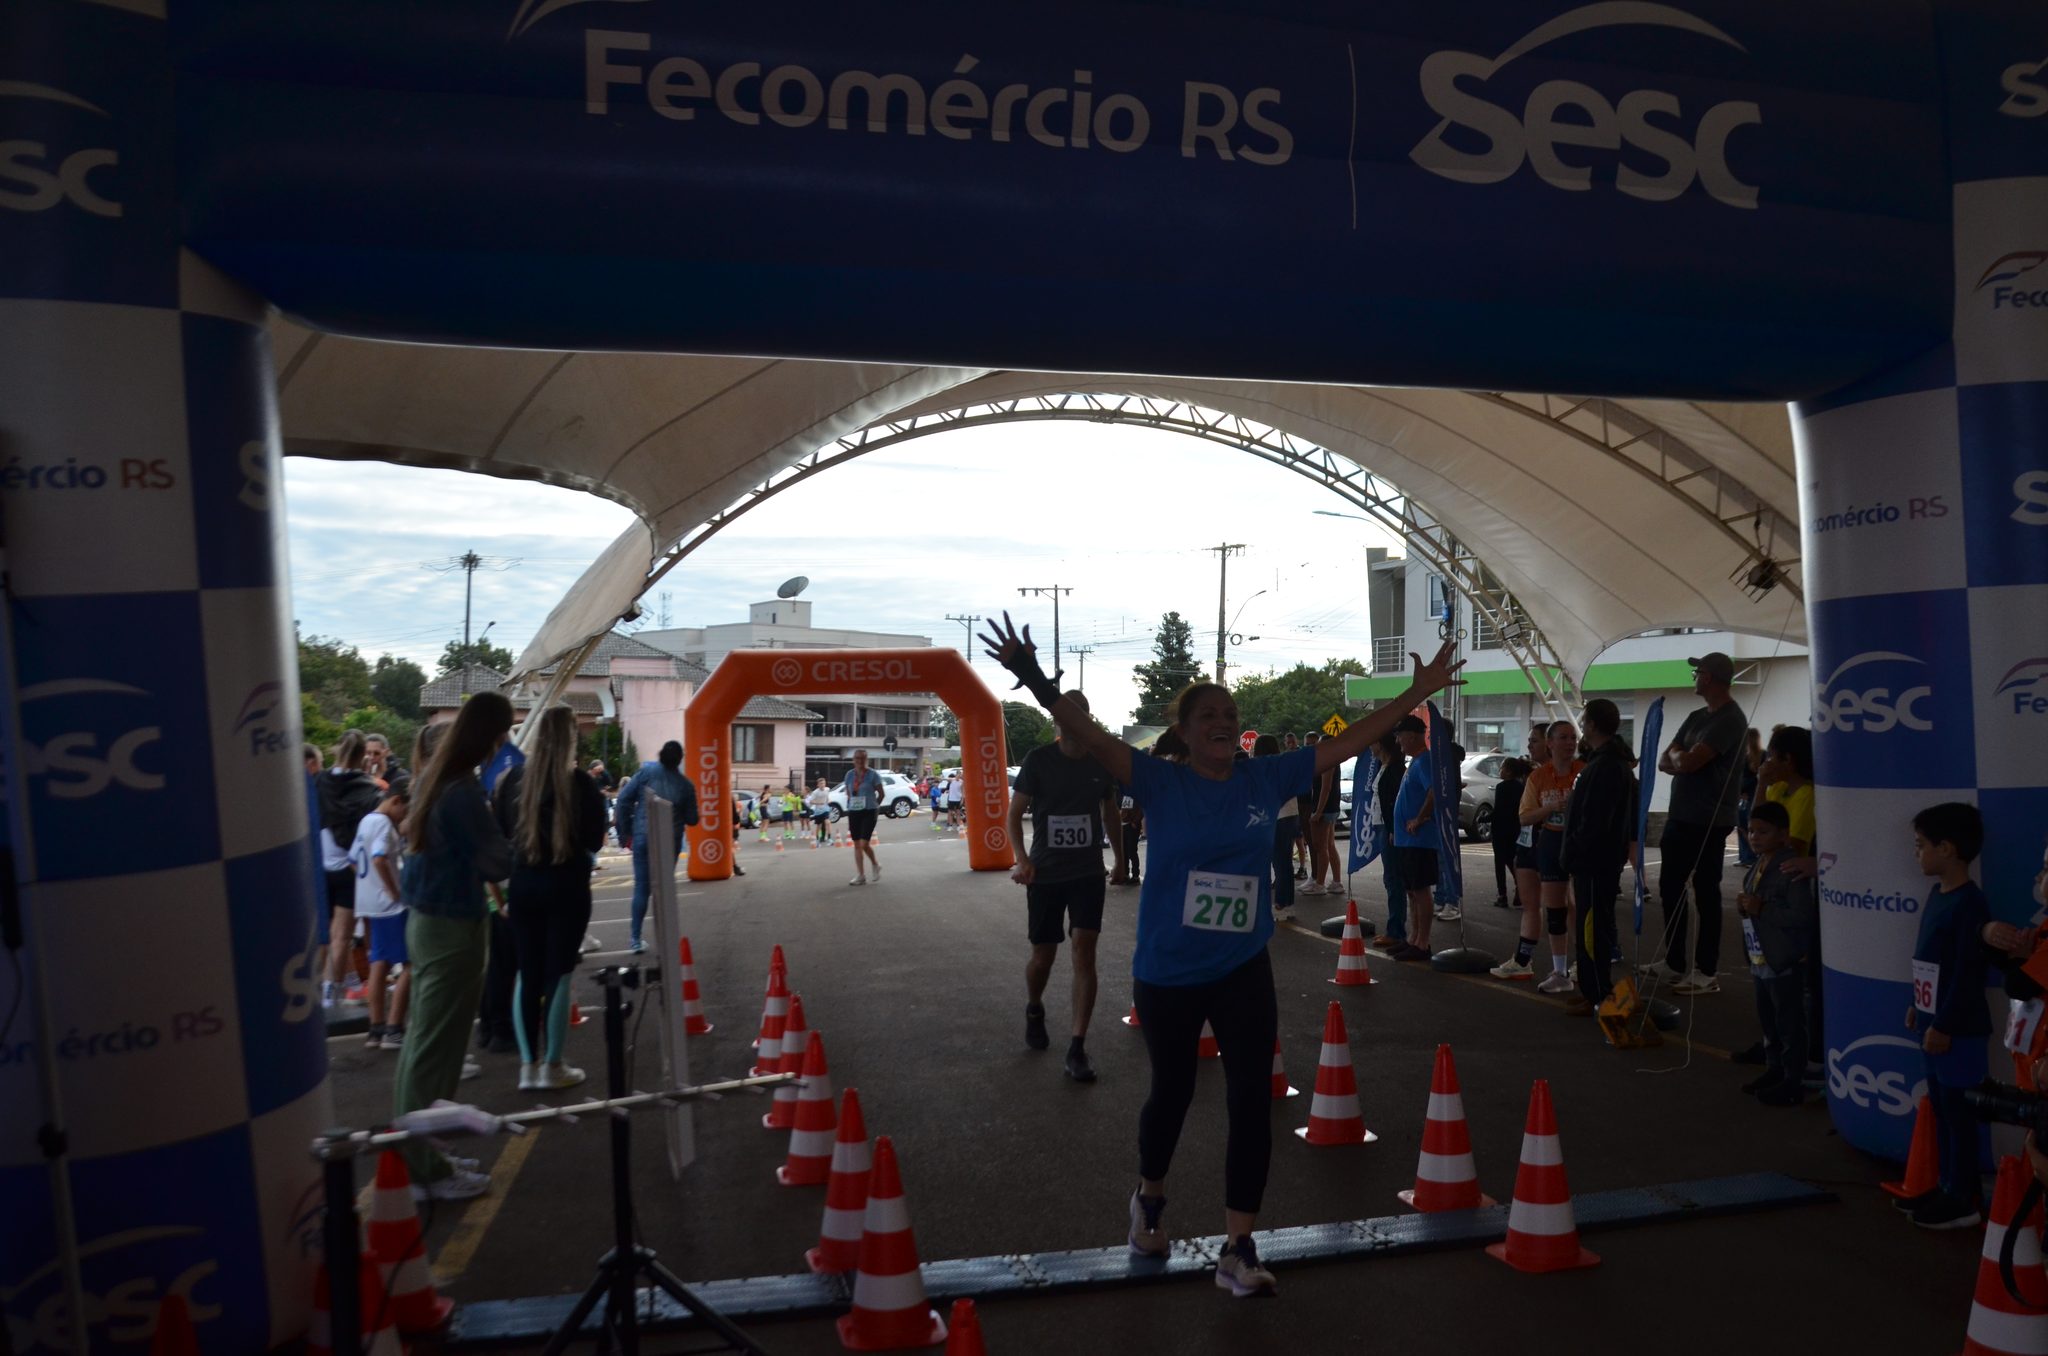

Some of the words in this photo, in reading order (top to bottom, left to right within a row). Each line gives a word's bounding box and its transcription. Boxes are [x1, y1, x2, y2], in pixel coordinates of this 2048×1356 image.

[585, 28, 1151, 154] Fecomércio
[1180, 80, 1294, 166] RS
[120, 458, 175, 490] RS
[1908, 496, 1949, 520] RS
[811, 659, 922, 682] CRESOL
[700, 738, 720, 832] CRESOL
[981, 728, 1003, 819] CRESOL
[1054, 828, 1087, 846] 530
[1192, 894, 1248, 928] 278
[172, 1006, 224, 1042] RS
